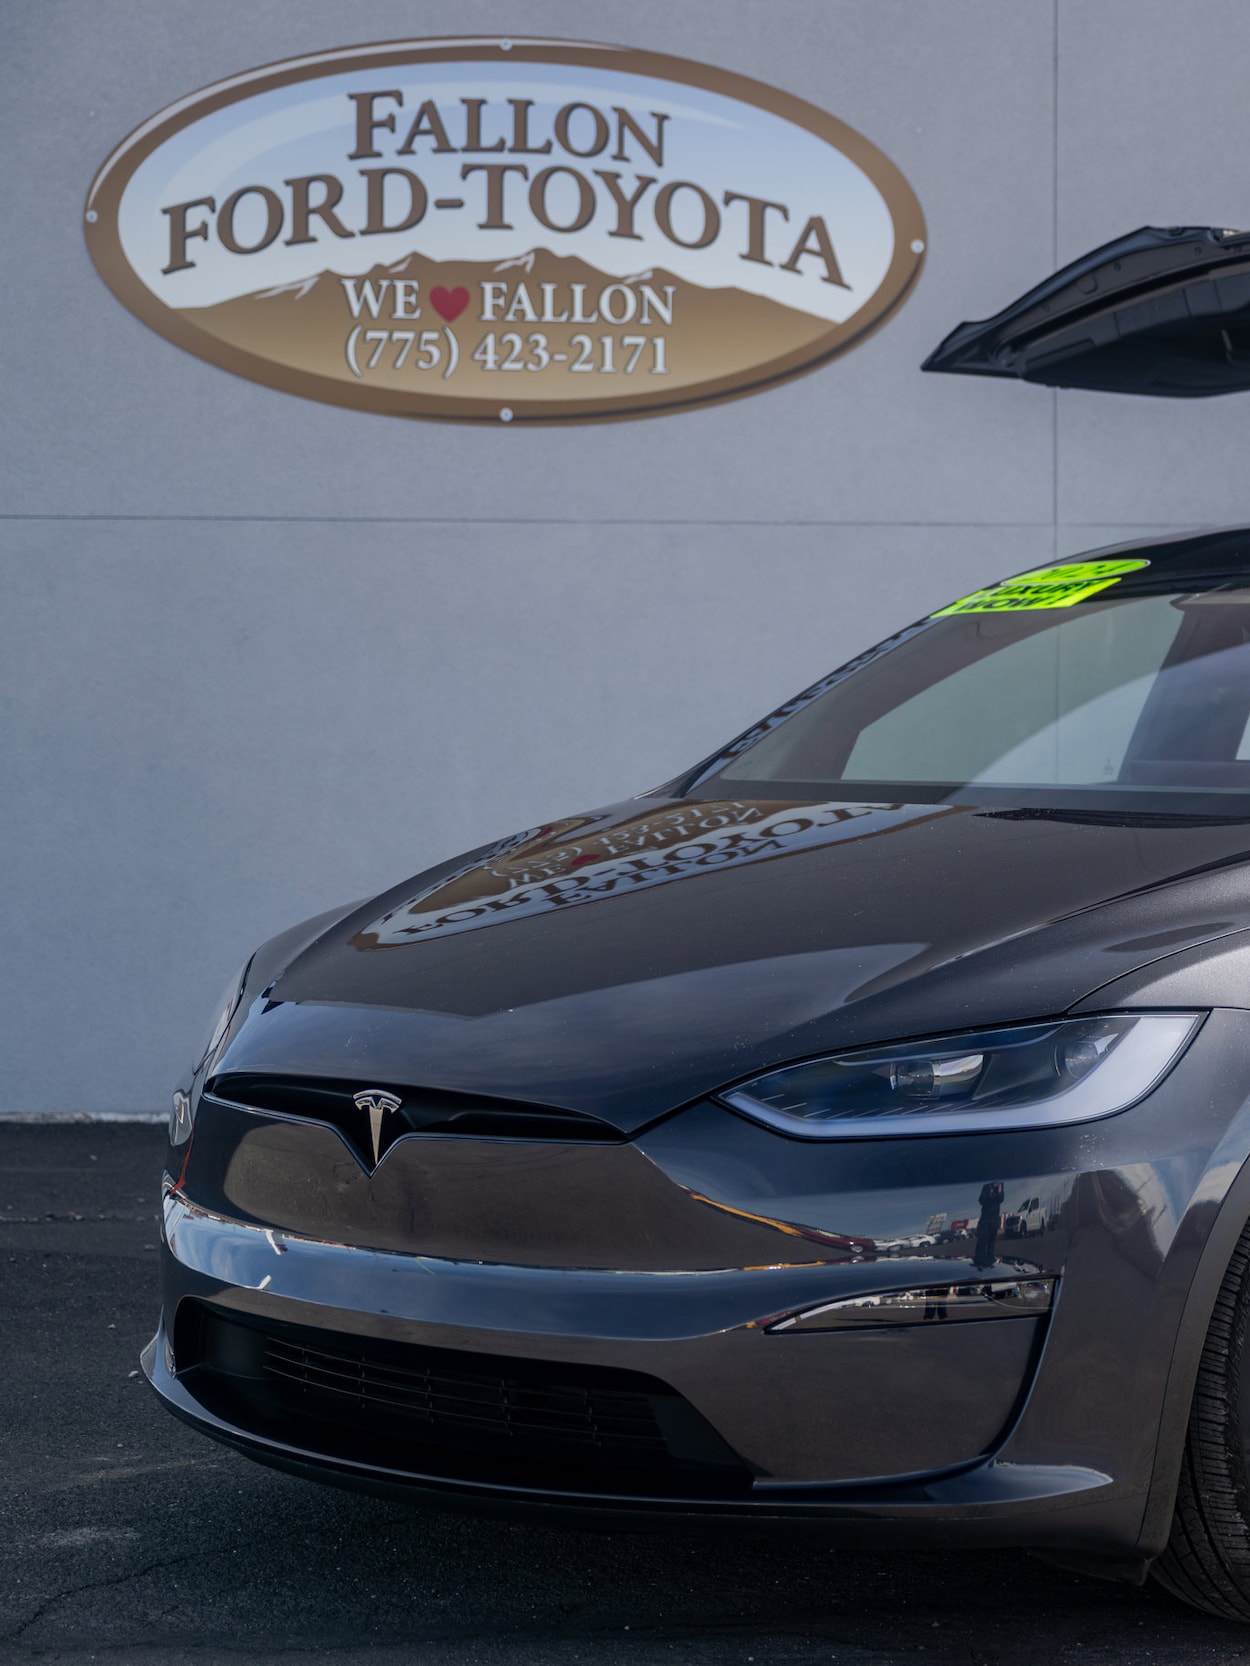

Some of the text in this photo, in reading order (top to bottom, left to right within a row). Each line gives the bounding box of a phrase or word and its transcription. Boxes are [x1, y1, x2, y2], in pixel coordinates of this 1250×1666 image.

[347, 88, 670, 168] FALLON
[160, 162, 855, 292] FORD-TOYOTA
[341, 278, 677, 326] WE FALLON
[345, 327, 669, 378] (775) 423-2171
